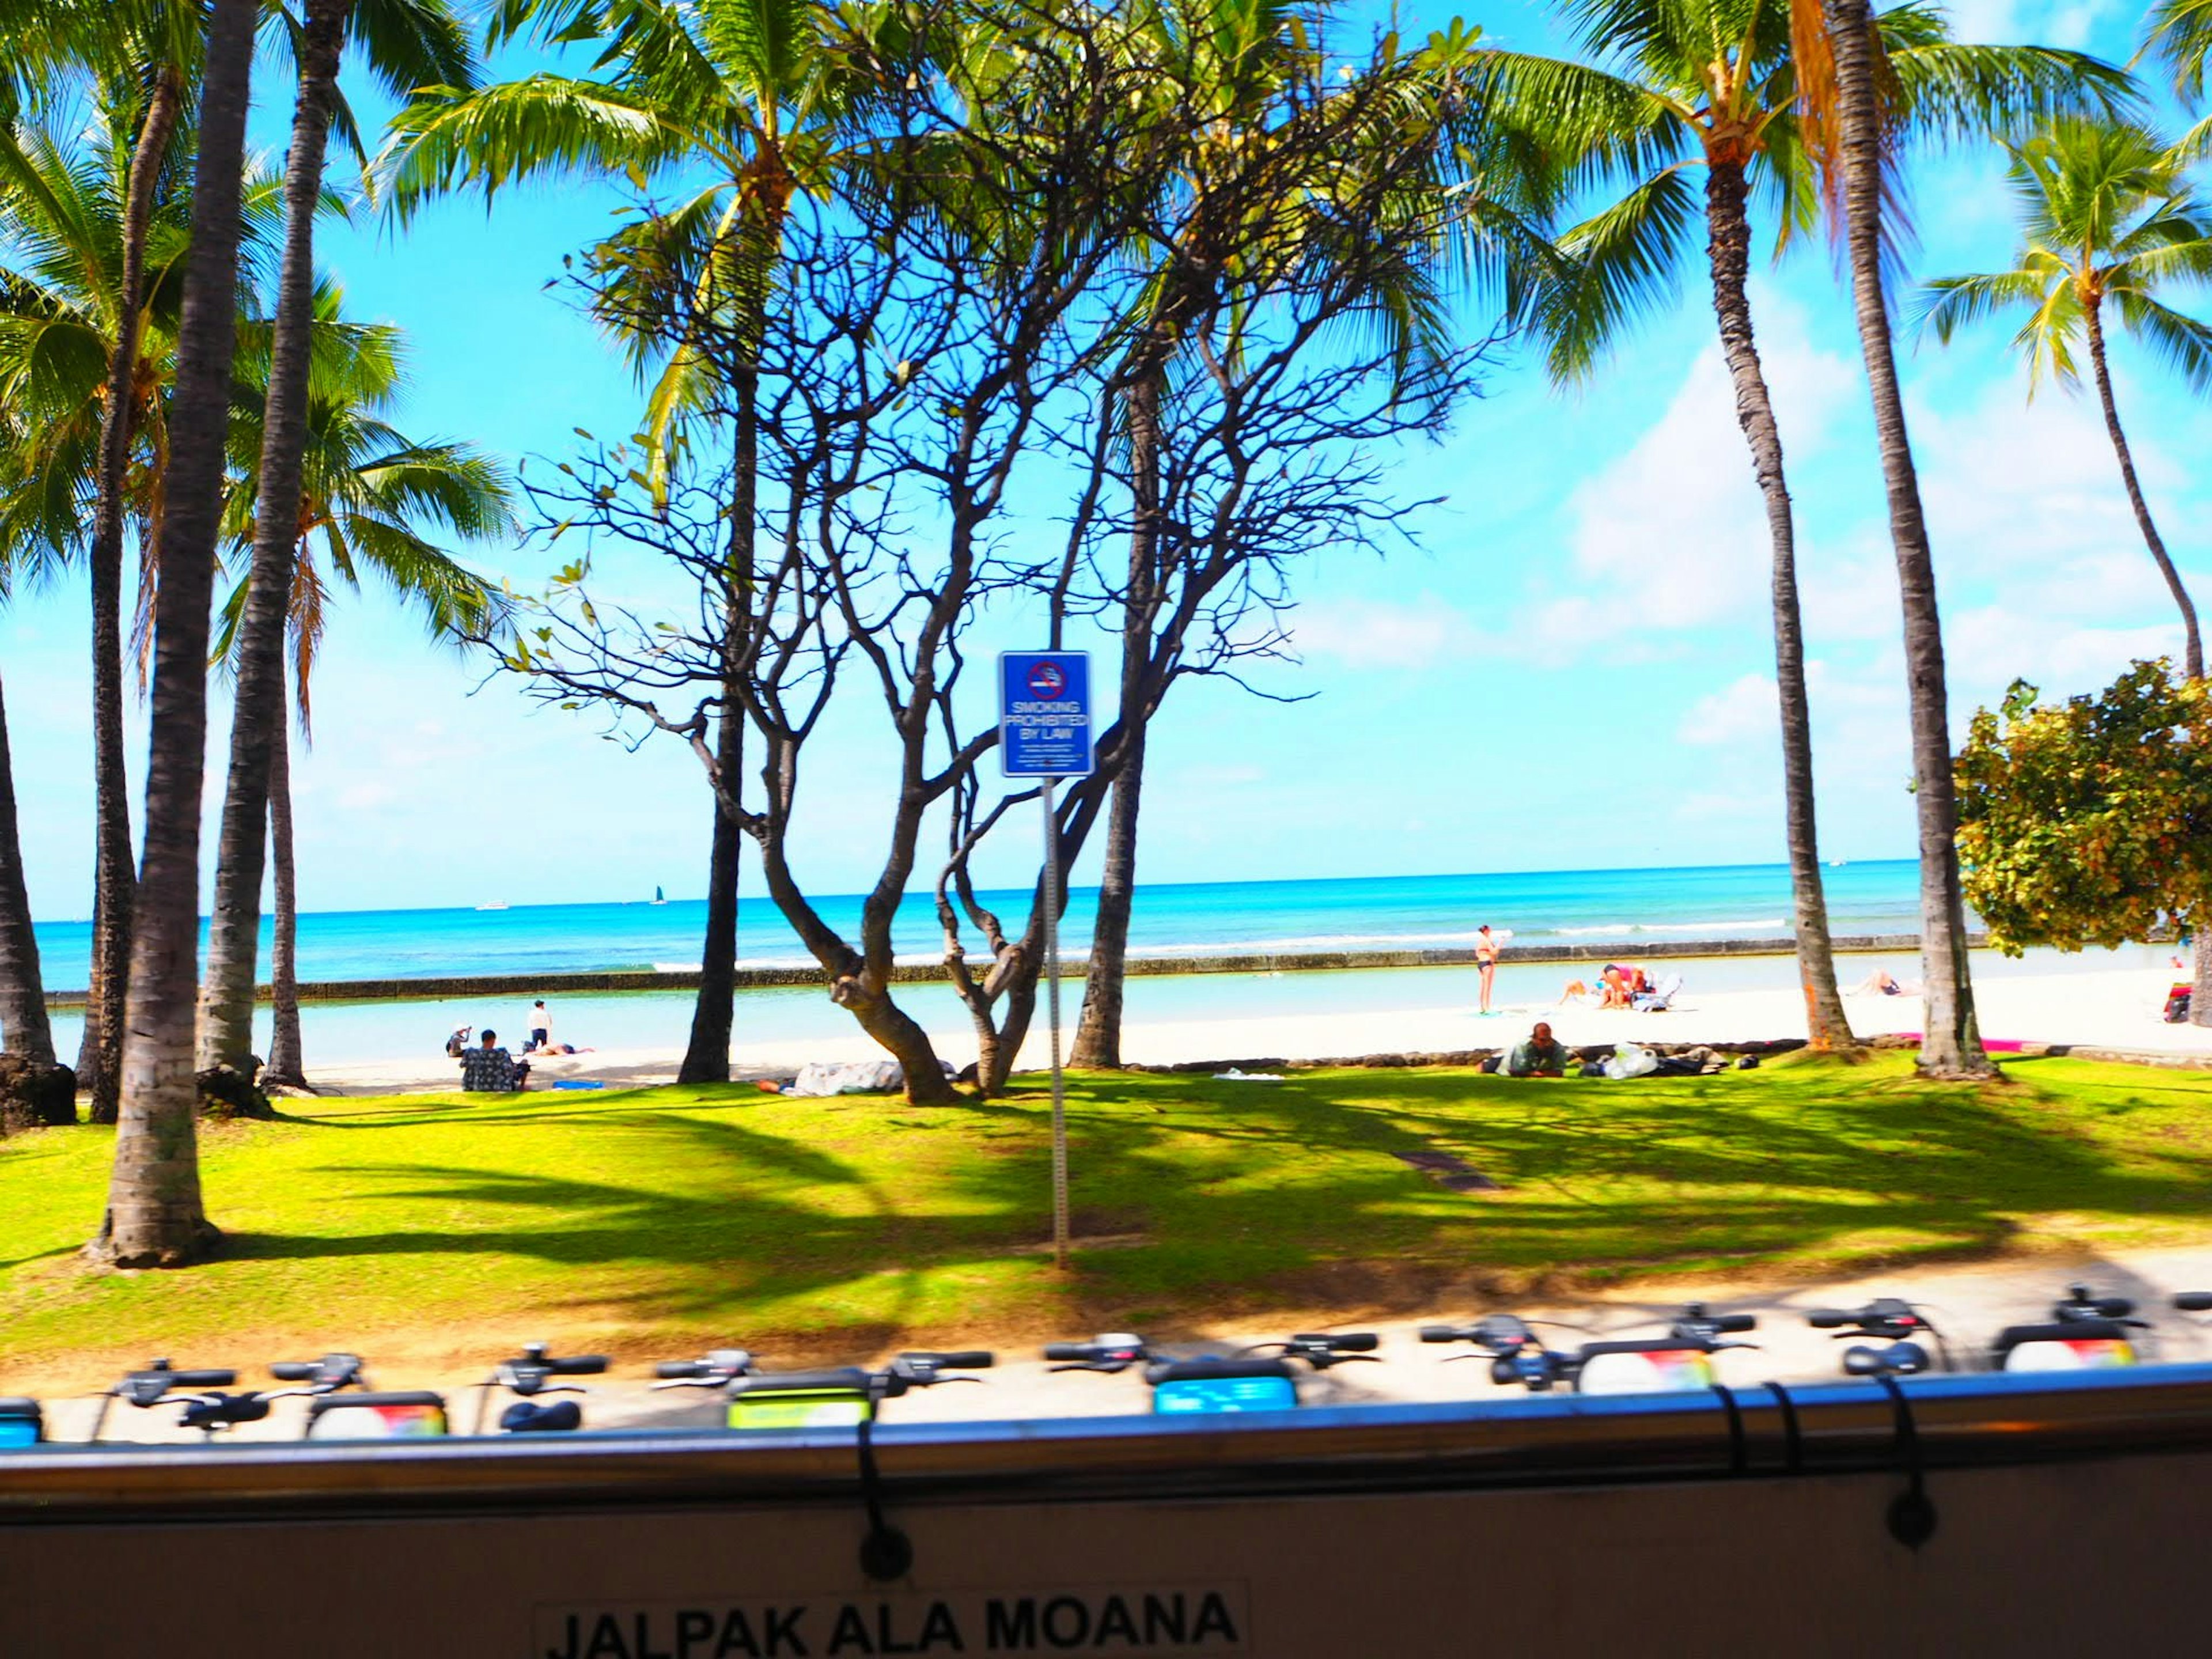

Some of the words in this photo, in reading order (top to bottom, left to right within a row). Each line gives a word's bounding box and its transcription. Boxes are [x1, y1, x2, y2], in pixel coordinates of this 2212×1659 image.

[1012, 701, 1081, 714] SMOKING
[1005, 714, 1088, 727] PROHIBITED
[1019, 728, 1039, 740] BY
[1041, 728, 1074, 740] LAW
[546, 1605, 811, 1659] JALPAK
[826, 1599, 965, 1655] ALA
[985, 1590, 1240, 1650] MOANA
